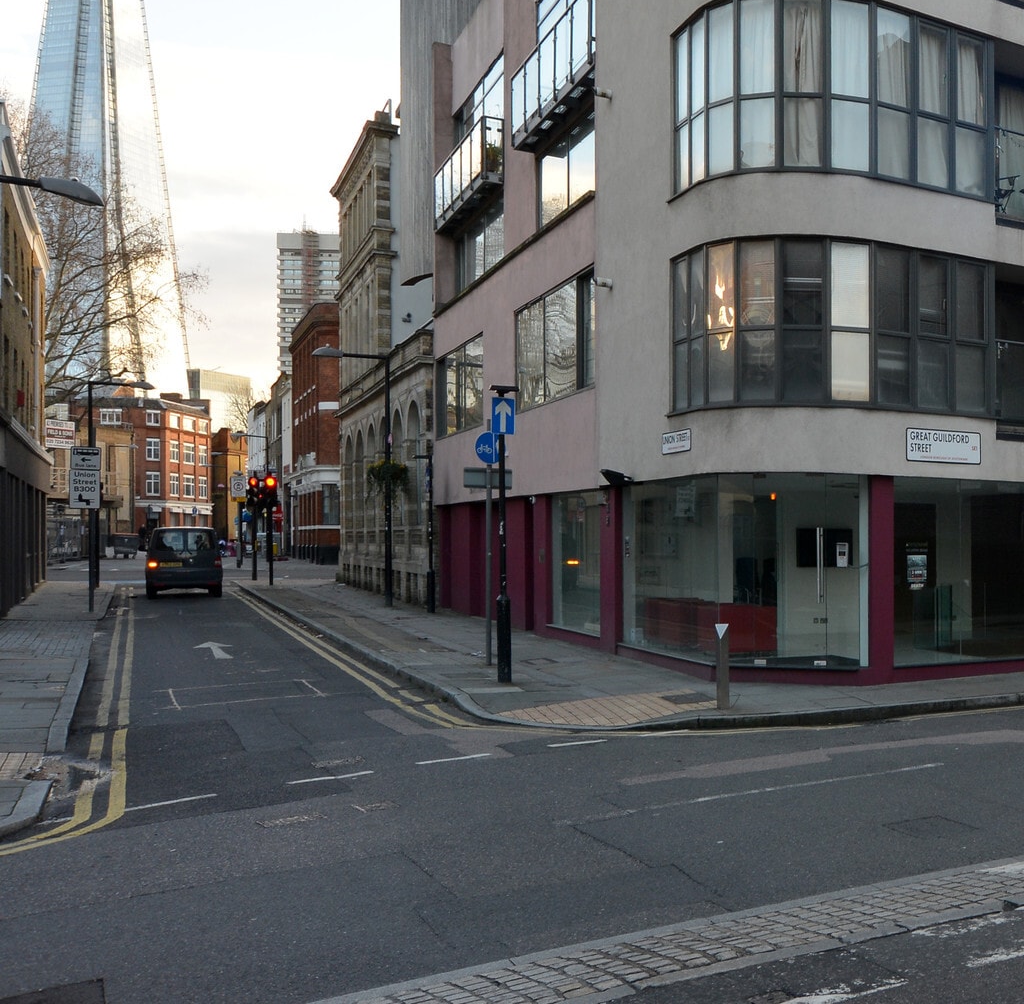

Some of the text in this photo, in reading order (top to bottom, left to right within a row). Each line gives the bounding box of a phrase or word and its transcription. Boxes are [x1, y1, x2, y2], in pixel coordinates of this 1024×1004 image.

[910, 431, 970, 444] GREAT GUILDFORD
[910, 442, 932, 453] STREET
[73, 485, 96, 493] B300
